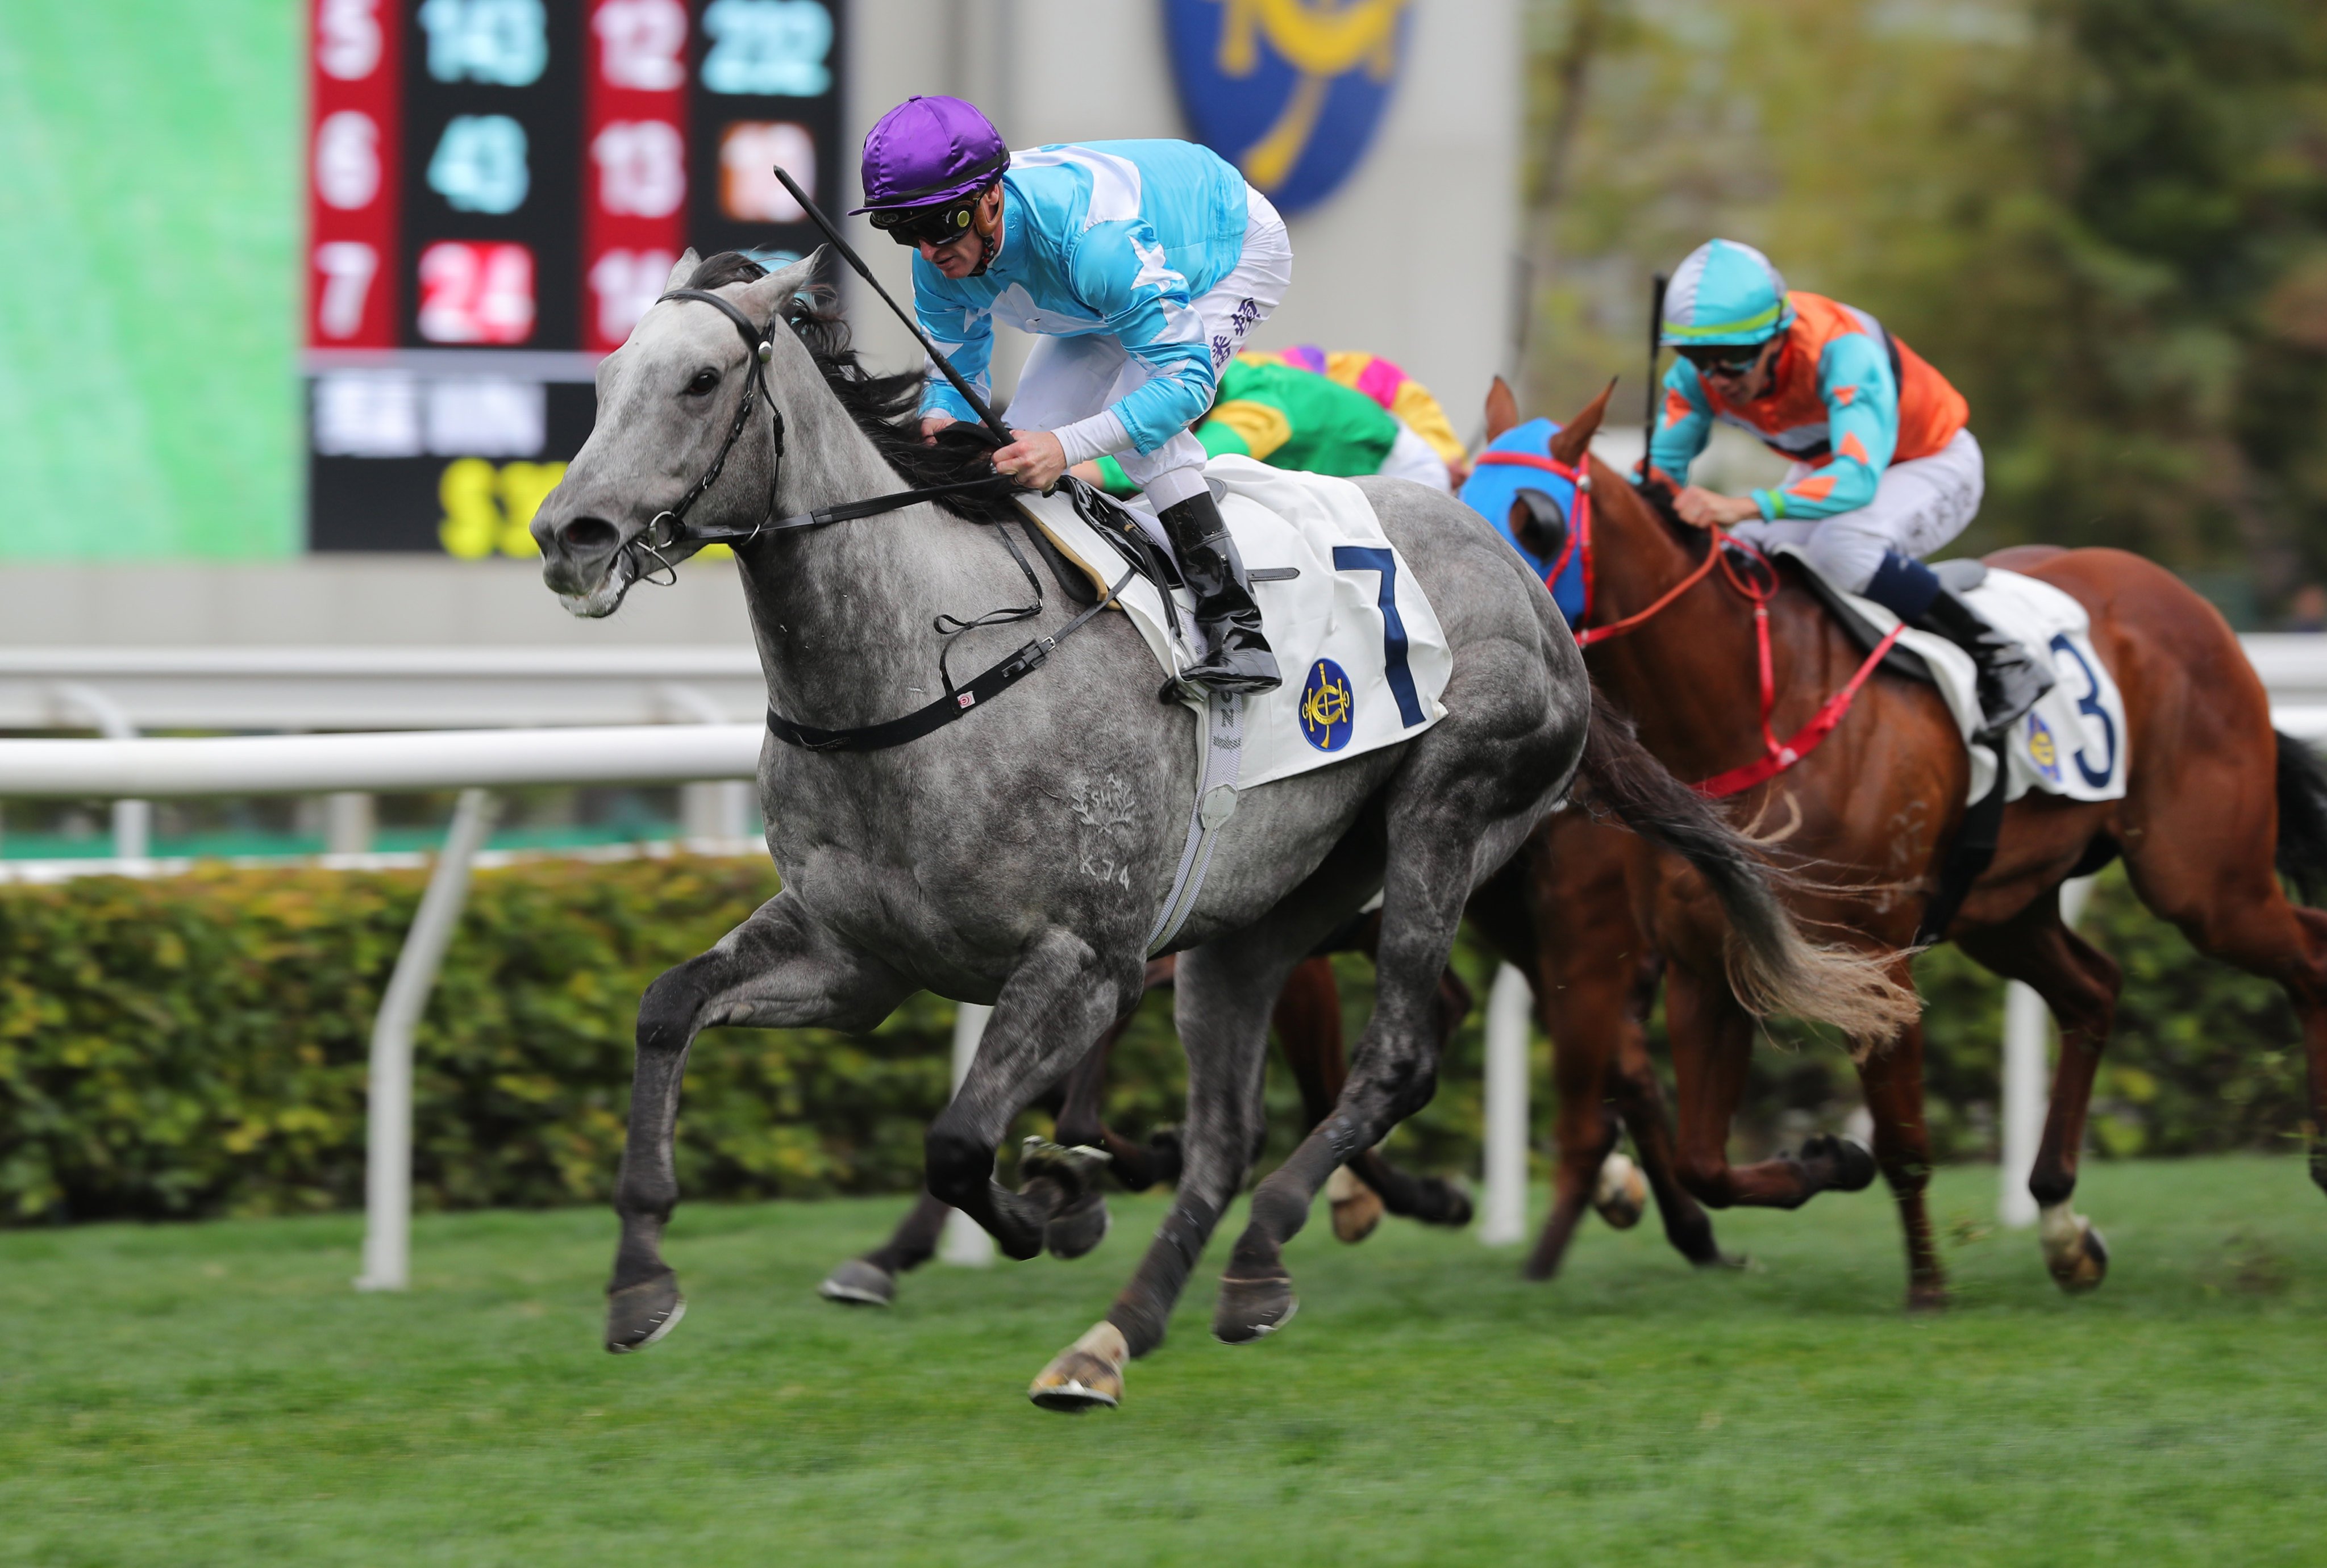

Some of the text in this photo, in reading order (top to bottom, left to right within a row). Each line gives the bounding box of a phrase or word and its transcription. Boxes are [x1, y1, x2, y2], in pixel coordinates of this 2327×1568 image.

[316, 0, 383, 81] 5
[315, 110, 382, 210] 6
[426, 114, 531, 215] 43
[314, 241, 379, 340] 7
[1332, 545, 1427, 729] 7
[2049, 633, 2116, 789] 3
